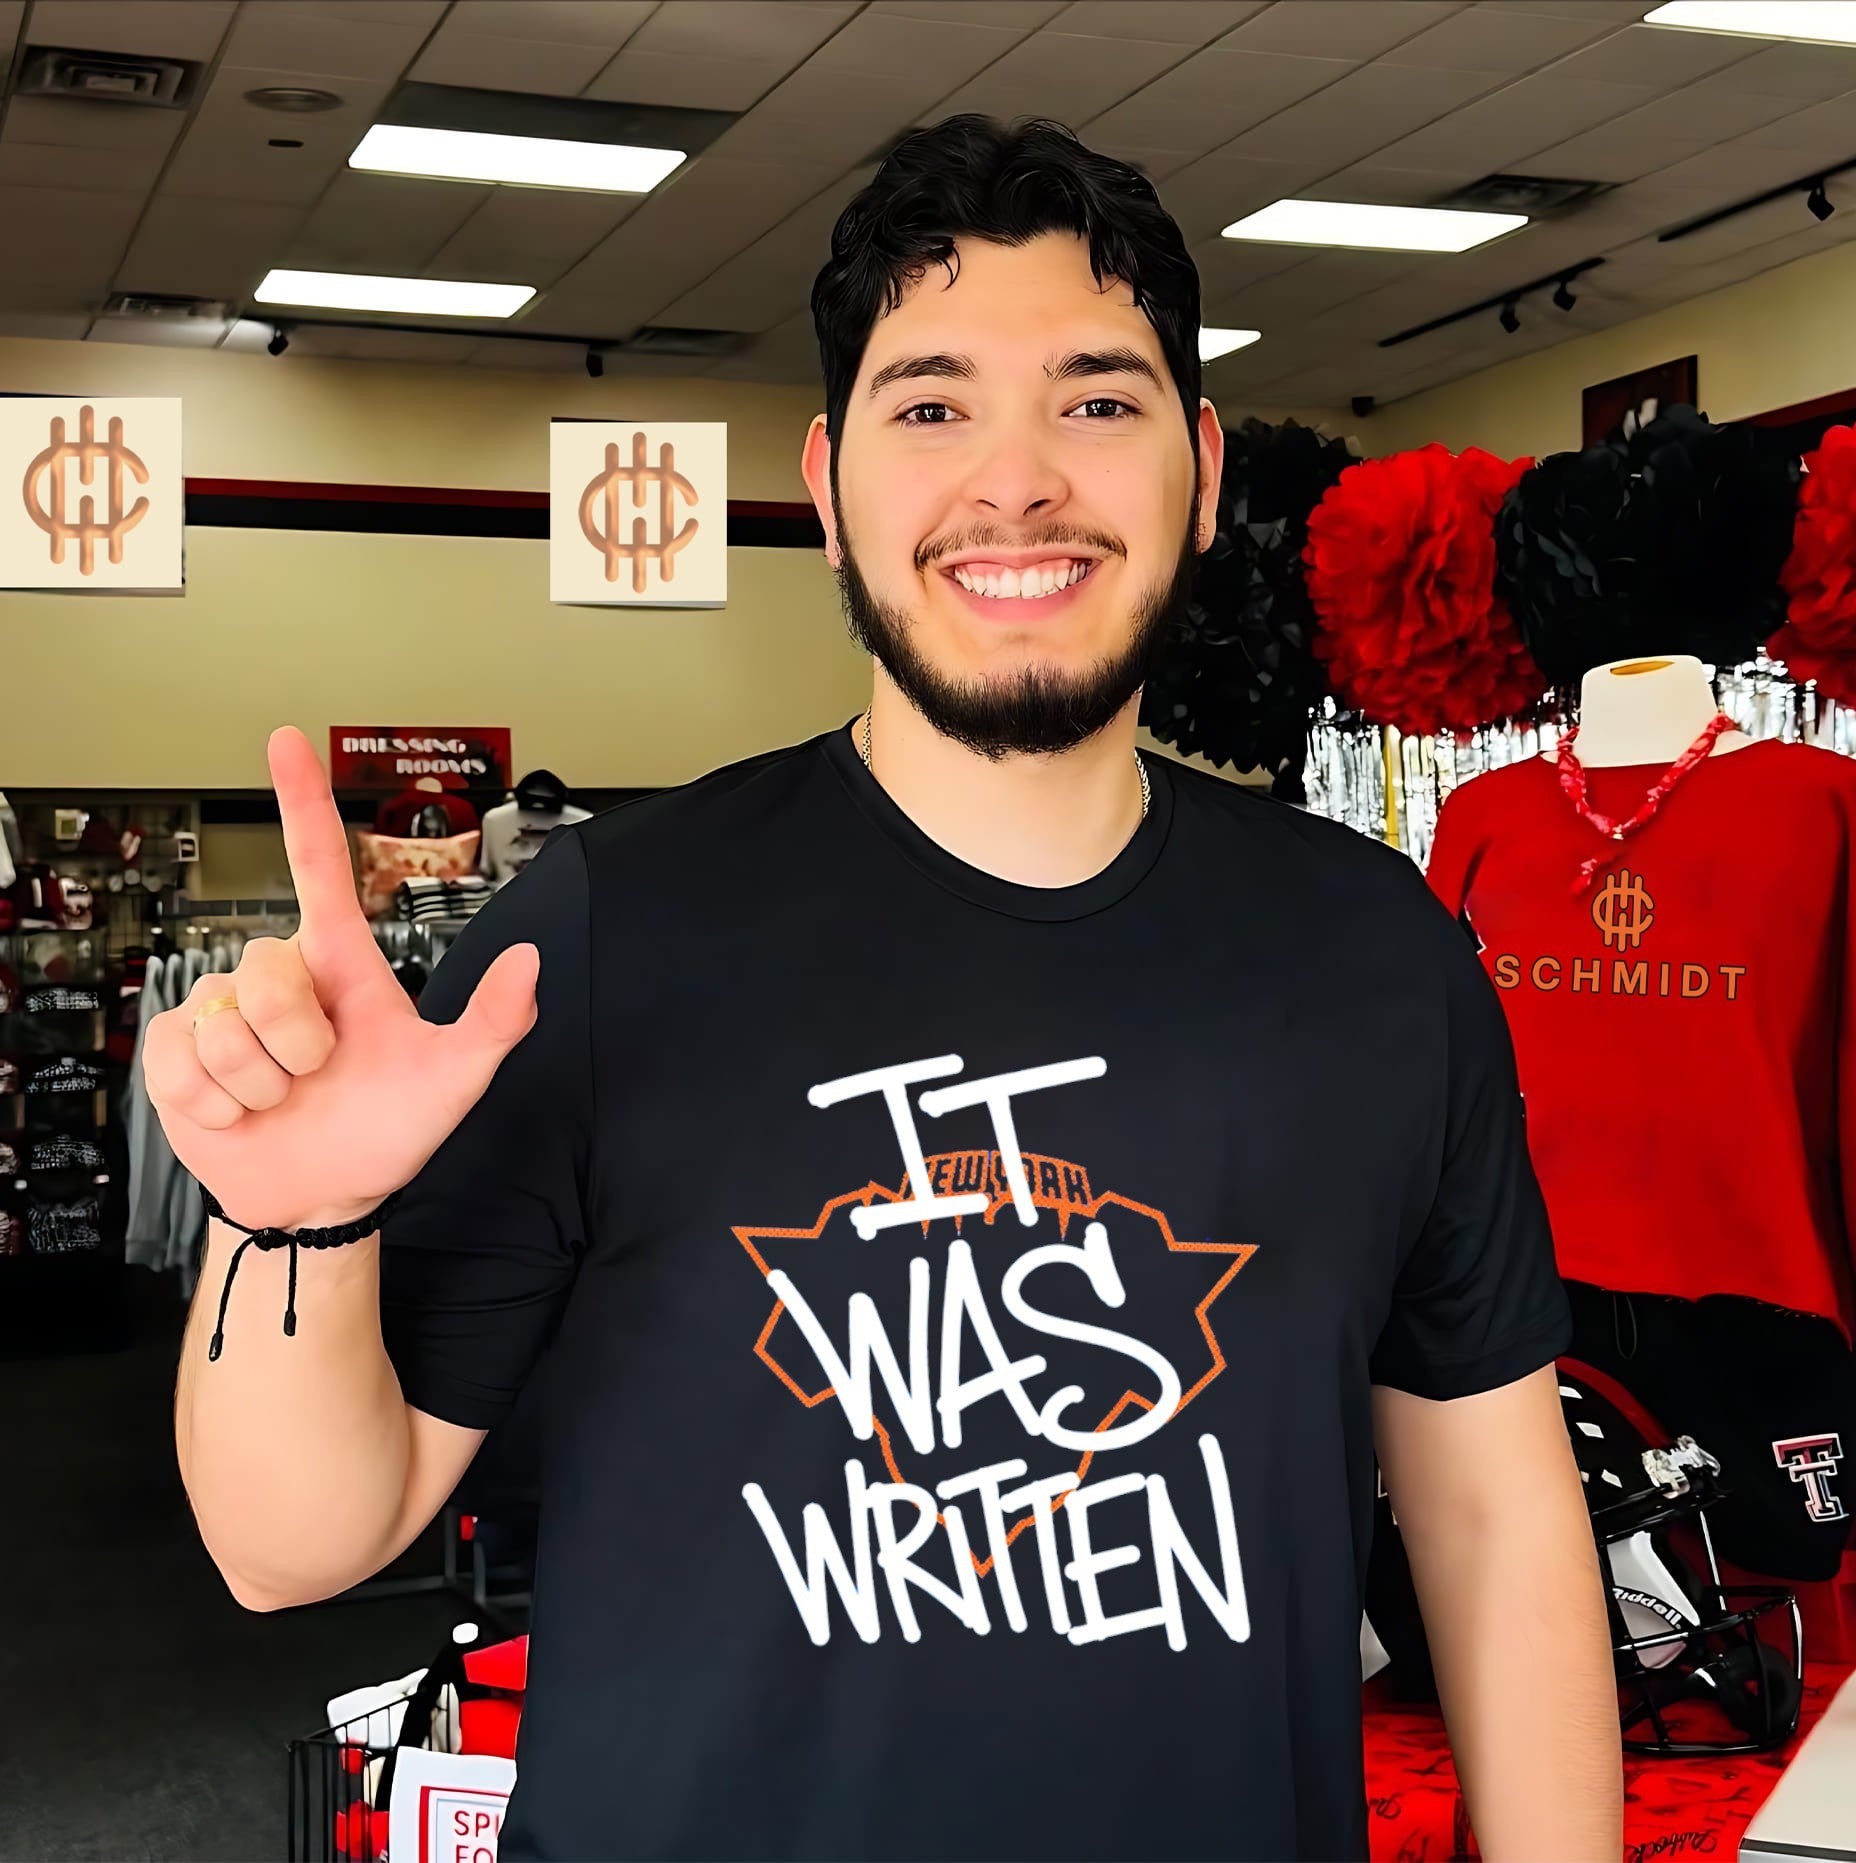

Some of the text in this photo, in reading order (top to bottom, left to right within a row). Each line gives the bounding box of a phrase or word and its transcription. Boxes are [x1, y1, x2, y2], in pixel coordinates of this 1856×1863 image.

[342, 737, 466, 753] DRESSING
[396, 758, 486, 775] ROOMS
[1494, 954, 1747, 1000] SCHMIDT
[807, 1053, 1107, 1241] IT
[768, 1222, 1182, 1454] WAS
